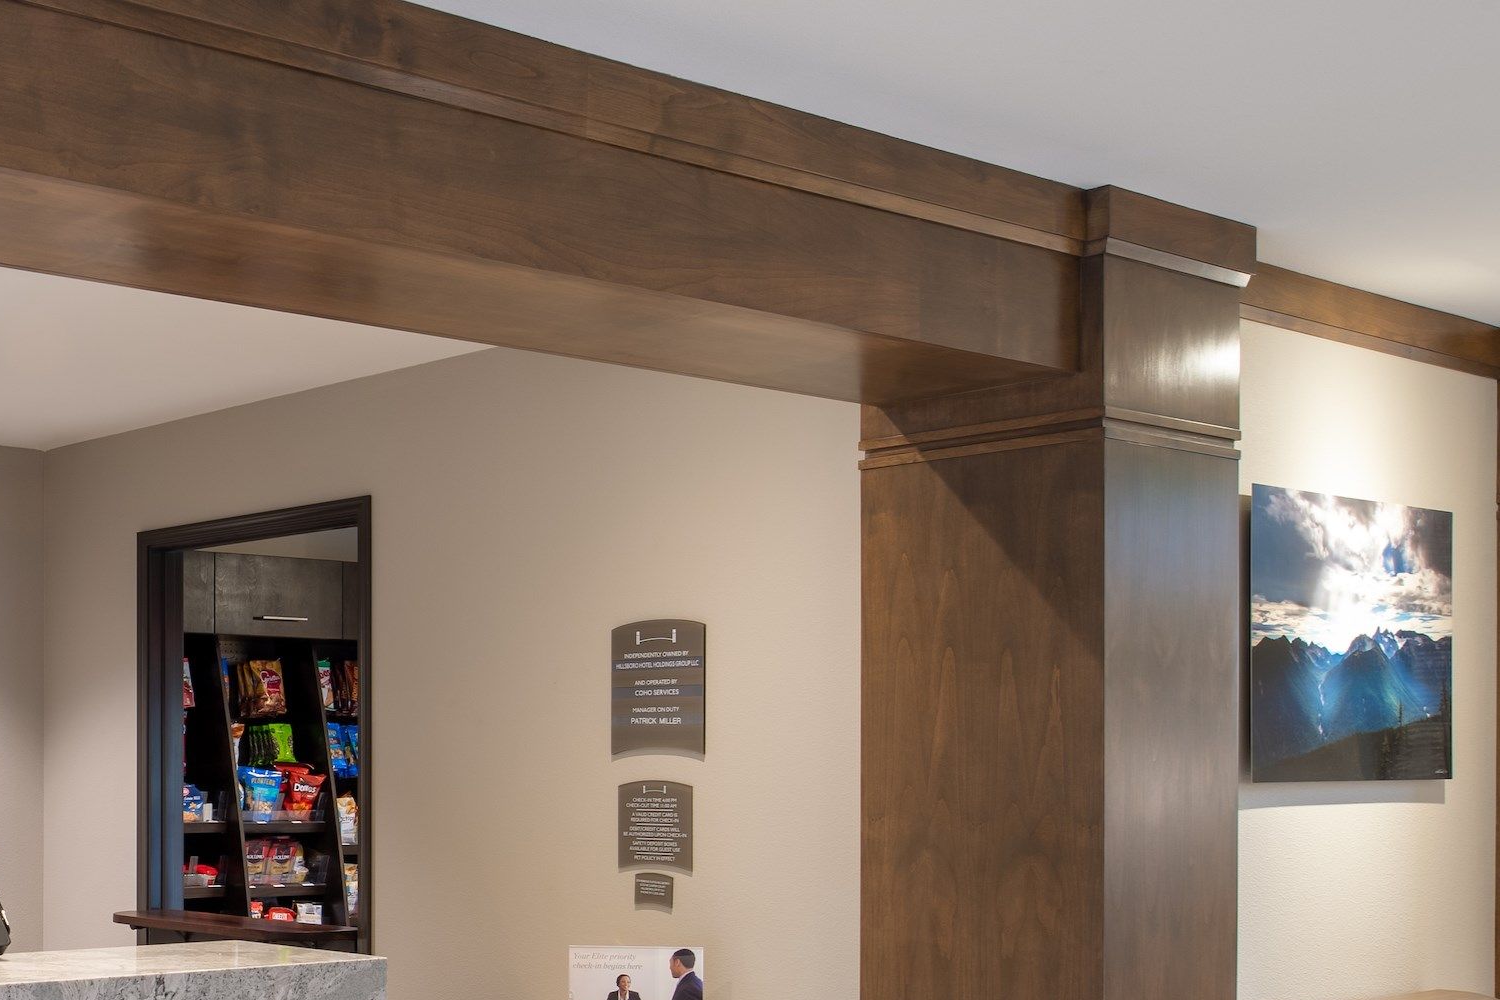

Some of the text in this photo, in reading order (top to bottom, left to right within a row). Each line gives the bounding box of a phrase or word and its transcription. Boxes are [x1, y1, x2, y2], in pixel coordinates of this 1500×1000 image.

[293, 783, 318, 793] Doritos
[573, 952, 636, 962] Your Elite priority
[603, 962, 626, 971] begins
